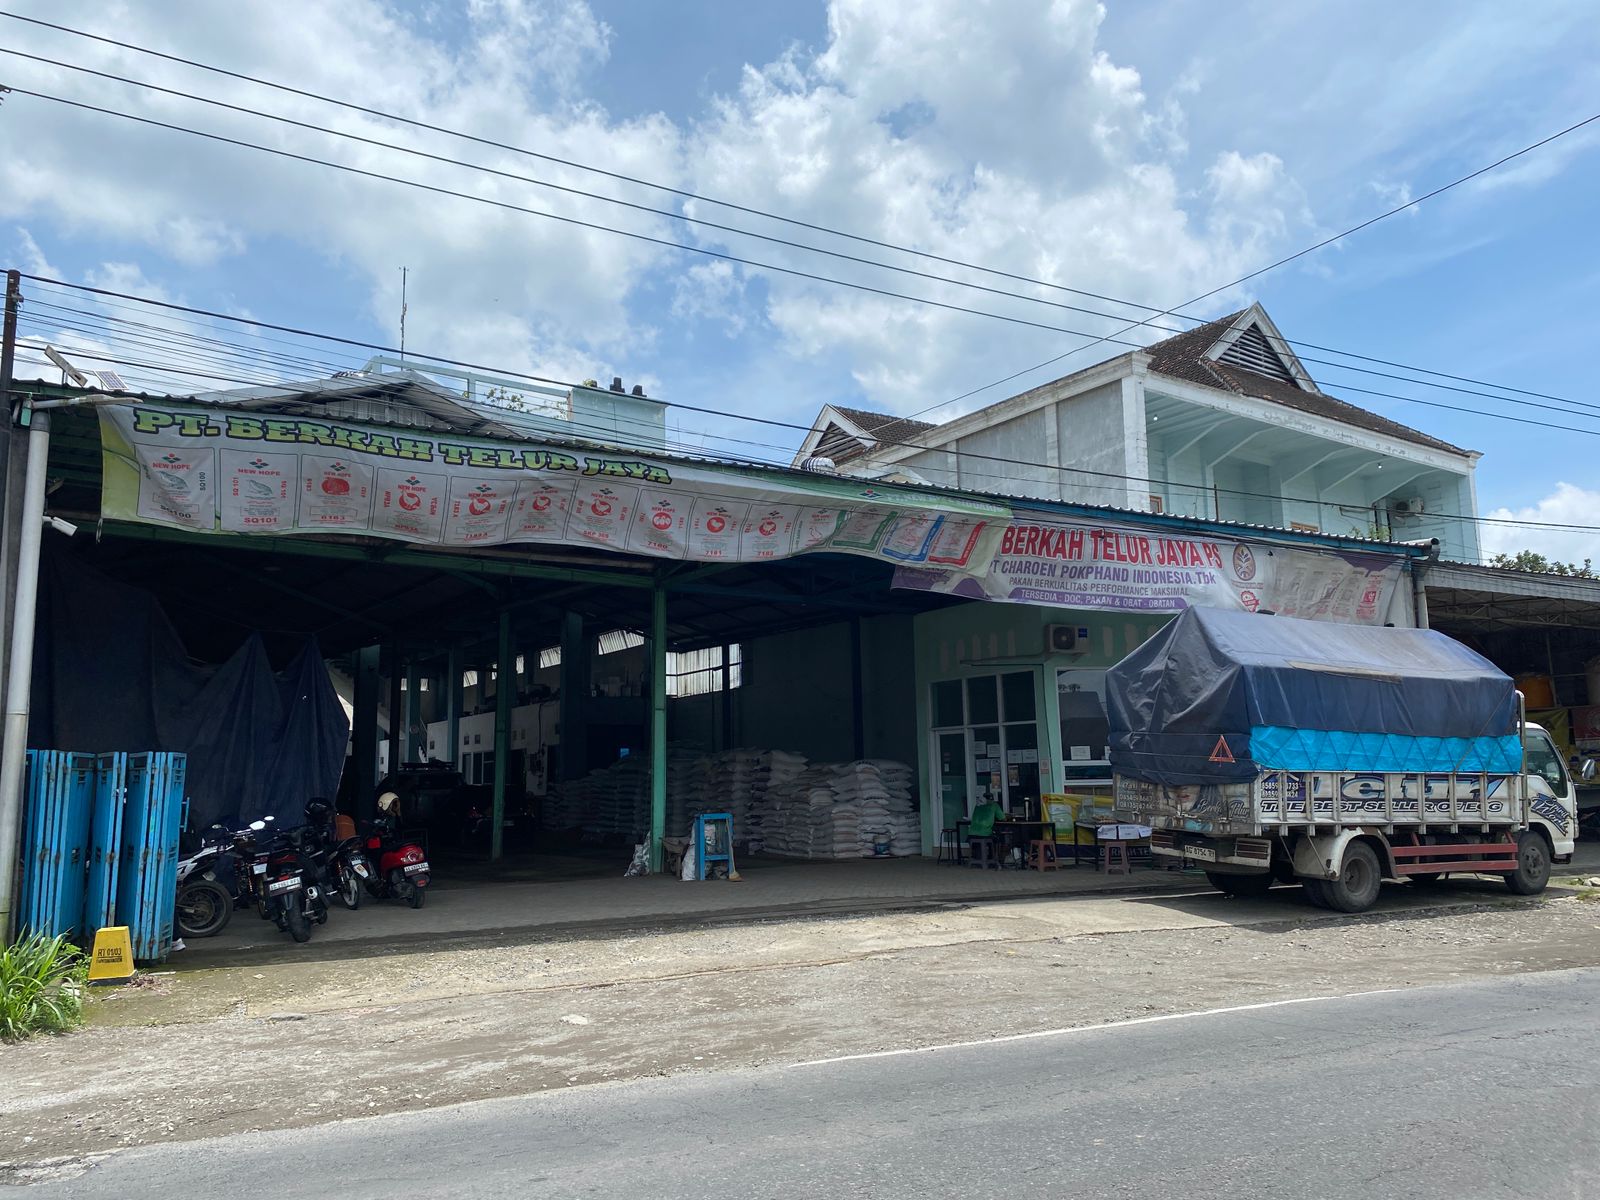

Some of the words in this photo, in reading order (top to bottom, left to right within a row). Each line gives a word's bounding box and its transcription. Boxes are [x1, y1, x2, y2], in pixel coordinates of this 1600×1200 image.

[134, 407, 220, 438] PT.
[226, 416, 434, 462] BERKAH
[438, 442, 579, 471] TELUR
[582, 458, 672, 484] JAYA
[1000, 524, 1084, 560] BERKAH
[1090, 528, 1151, 565] TELUR
[1156, 537, 1202, 569] JAYA
[1202, 542, 1224, 569] PS
[1001, 560, 1057, 576] CHAROEN
[1060, 565, 1129, 582] POKPHAND
[1009, 576, 1033, 587] PAKAN
[1034, 579, 1089, 592] BERKUALITAS
[1090, 583, 1149, 596] PERFORMANCE
[1150, 587, 1190, 596] MAKSIMAL
[1021, 590, 1058, 601] TERSEDIA
[1086, 596, 1112, 605] PAKAN
[1114, 597, 1120, 606] &
[1122, 598, 1142, 607] OBAT
[1149, 599, 1175, 608] OBATAN
[1364, 800, 1434, 812] SELLER
